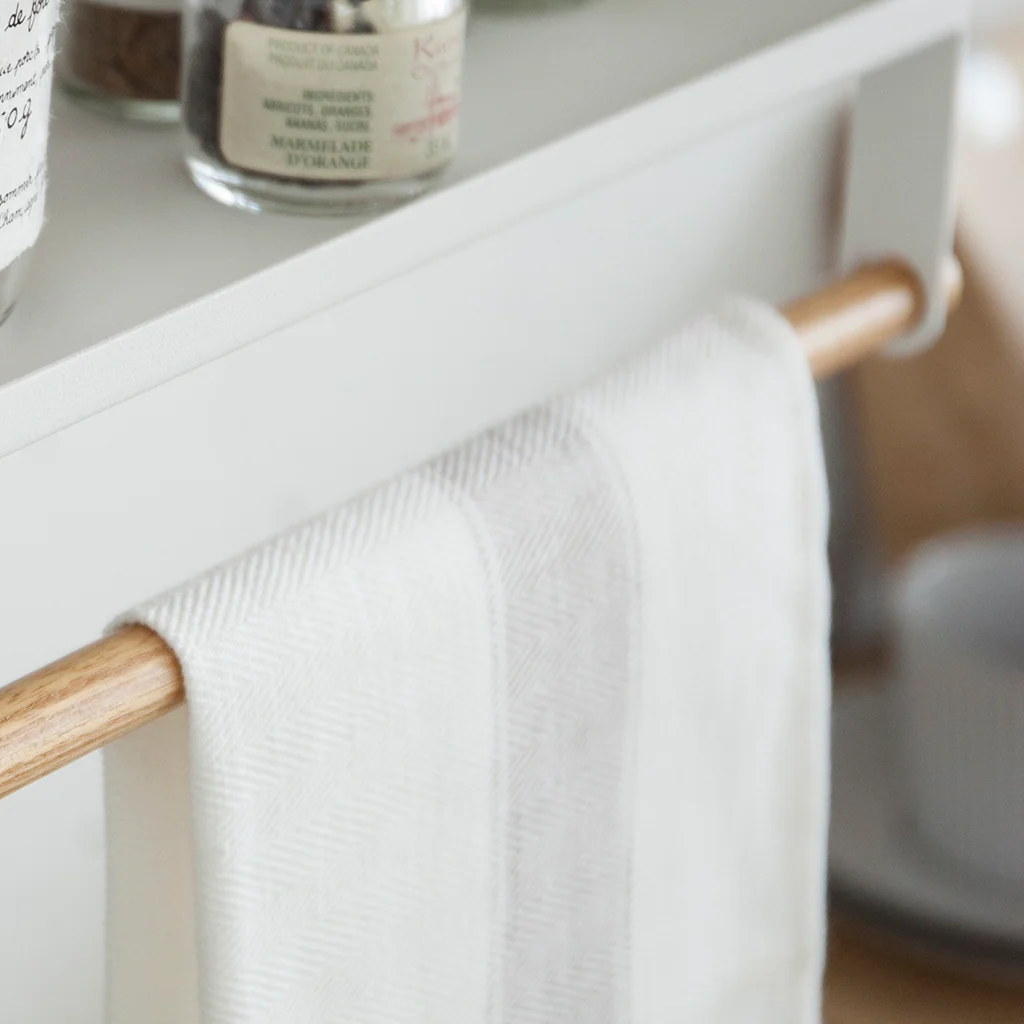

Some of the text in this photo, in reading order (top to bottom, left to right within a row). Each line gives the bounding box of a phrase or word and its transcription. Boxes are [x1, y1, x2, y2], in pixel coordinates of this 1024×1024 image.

[4, 2, 27, 32] de
[270, 134, 372, 154] MARMELADE
[286, 152, 372, 171] D'ORANGE
